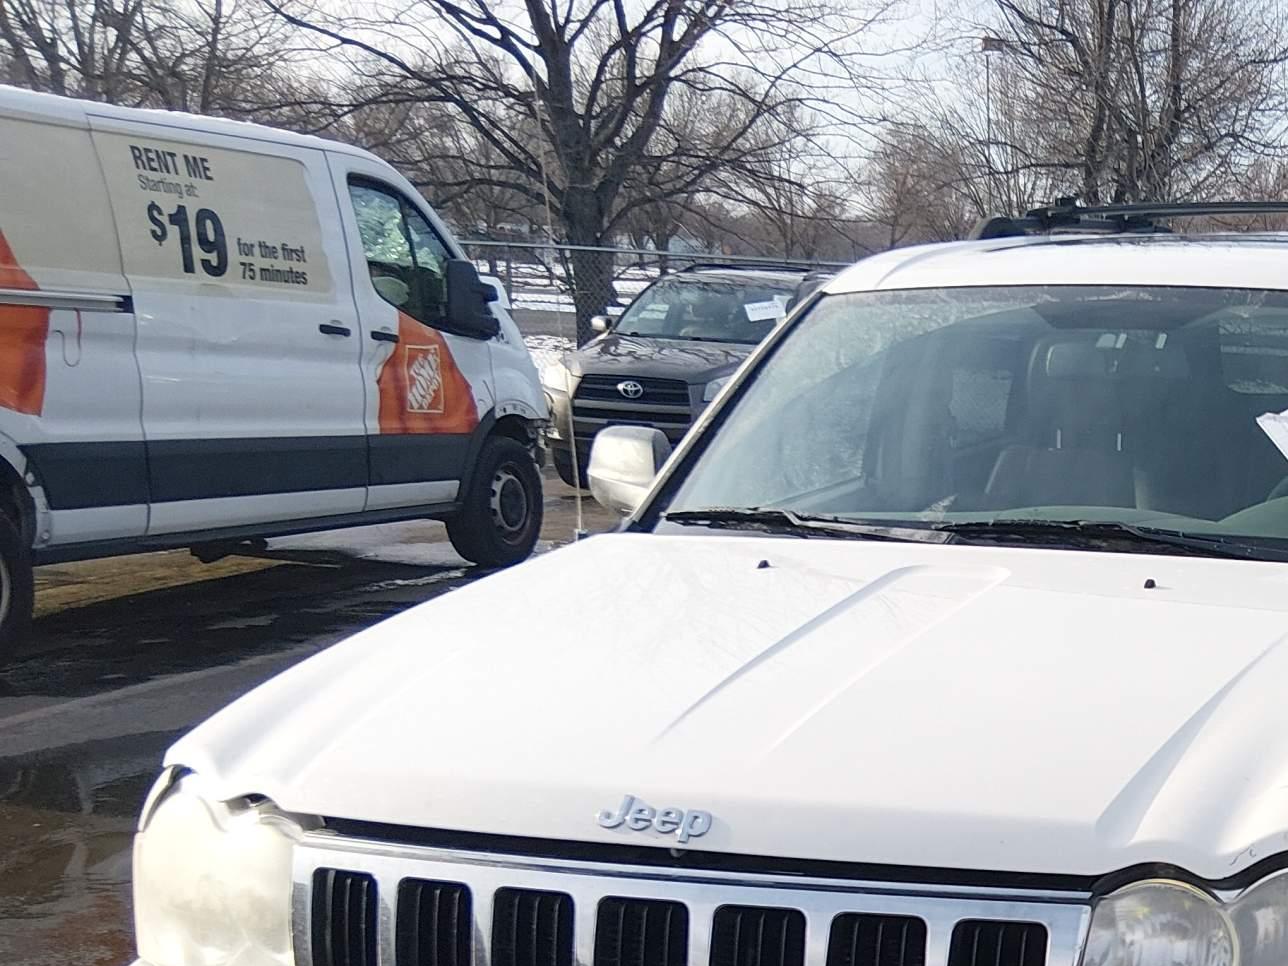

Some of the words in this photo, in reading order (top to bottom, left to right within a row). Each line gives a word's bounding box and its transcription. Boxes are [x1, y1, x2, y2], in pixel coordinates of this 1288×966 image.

[129, 145, 180, 176] RENT
[183, 154, 214, 181] ME
[137, 174, 184, 199] Starting
[147, 201, 229, 277] $19
[237, 238, 255, 257] for
[258, 240, 282, 260] the
[281, 242, 307, 263] first
[239, 261, 256, 281] 75
[259, 264, 308, 285] minutes
[597, 794, 713, 844] Jeep
